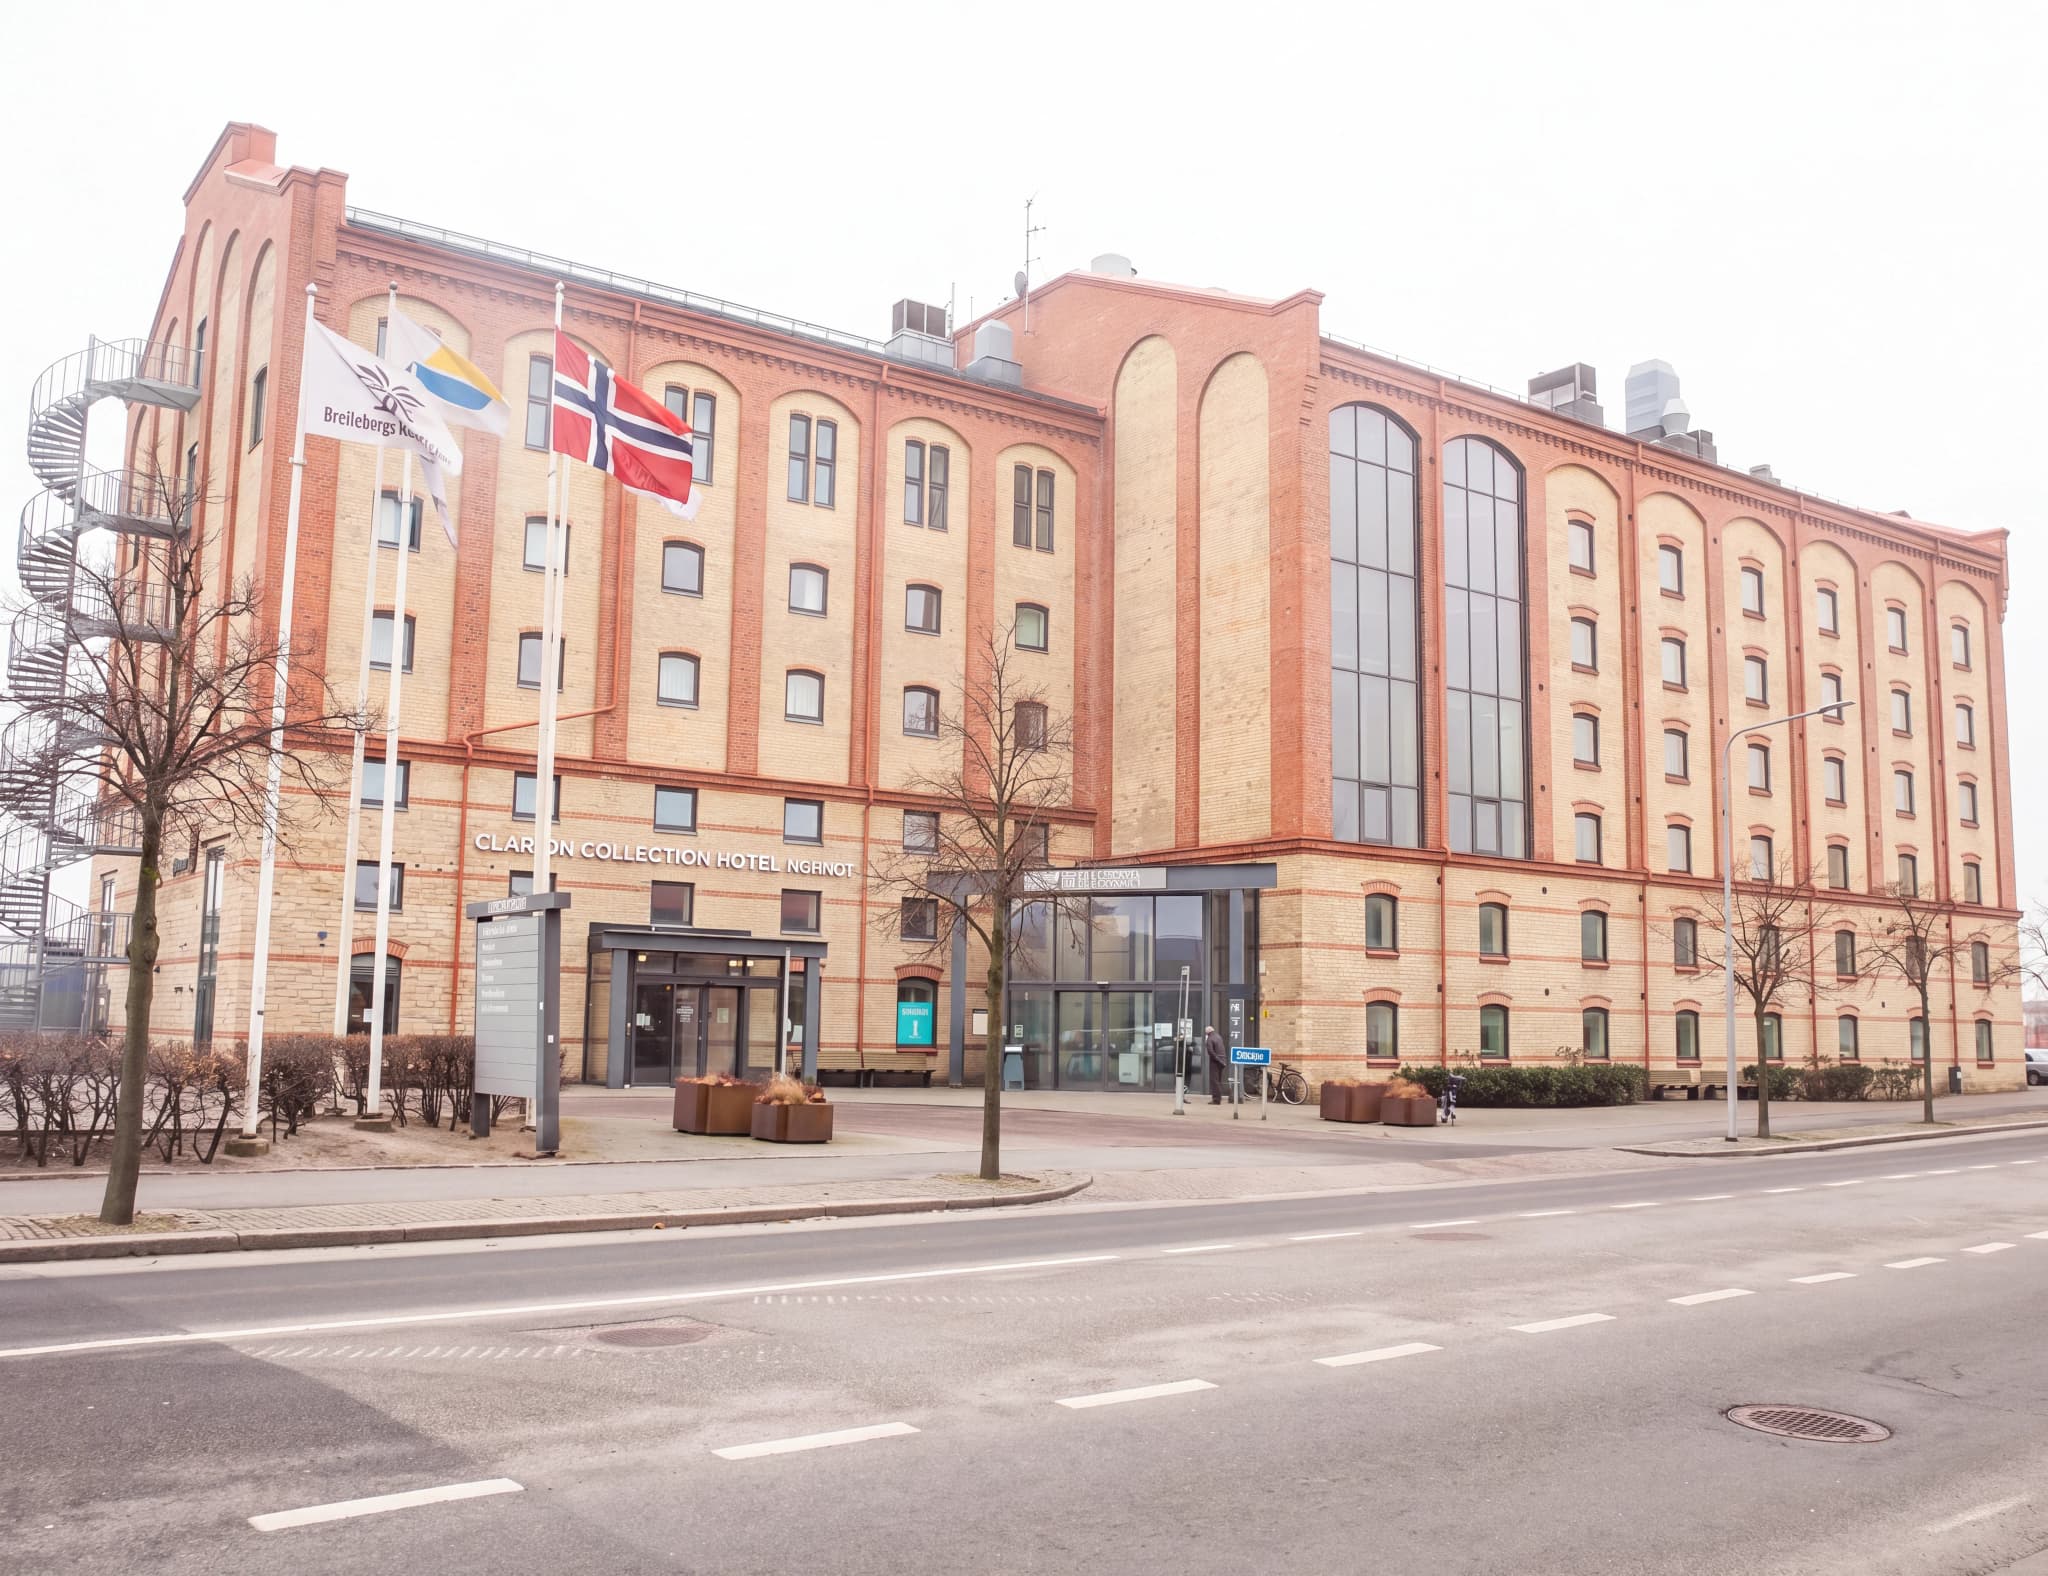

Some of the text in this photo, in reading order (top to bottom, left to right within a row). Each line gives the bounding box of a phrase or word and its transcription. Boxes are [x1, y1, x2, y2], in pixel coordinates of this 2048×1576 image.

[324, 406, 396, 437] Breilebergs
[475, 833, 575, 857] CLARON
[581, 842, 710, 867] COLLECTION
[717, 852, 781, 872] HOTEL
